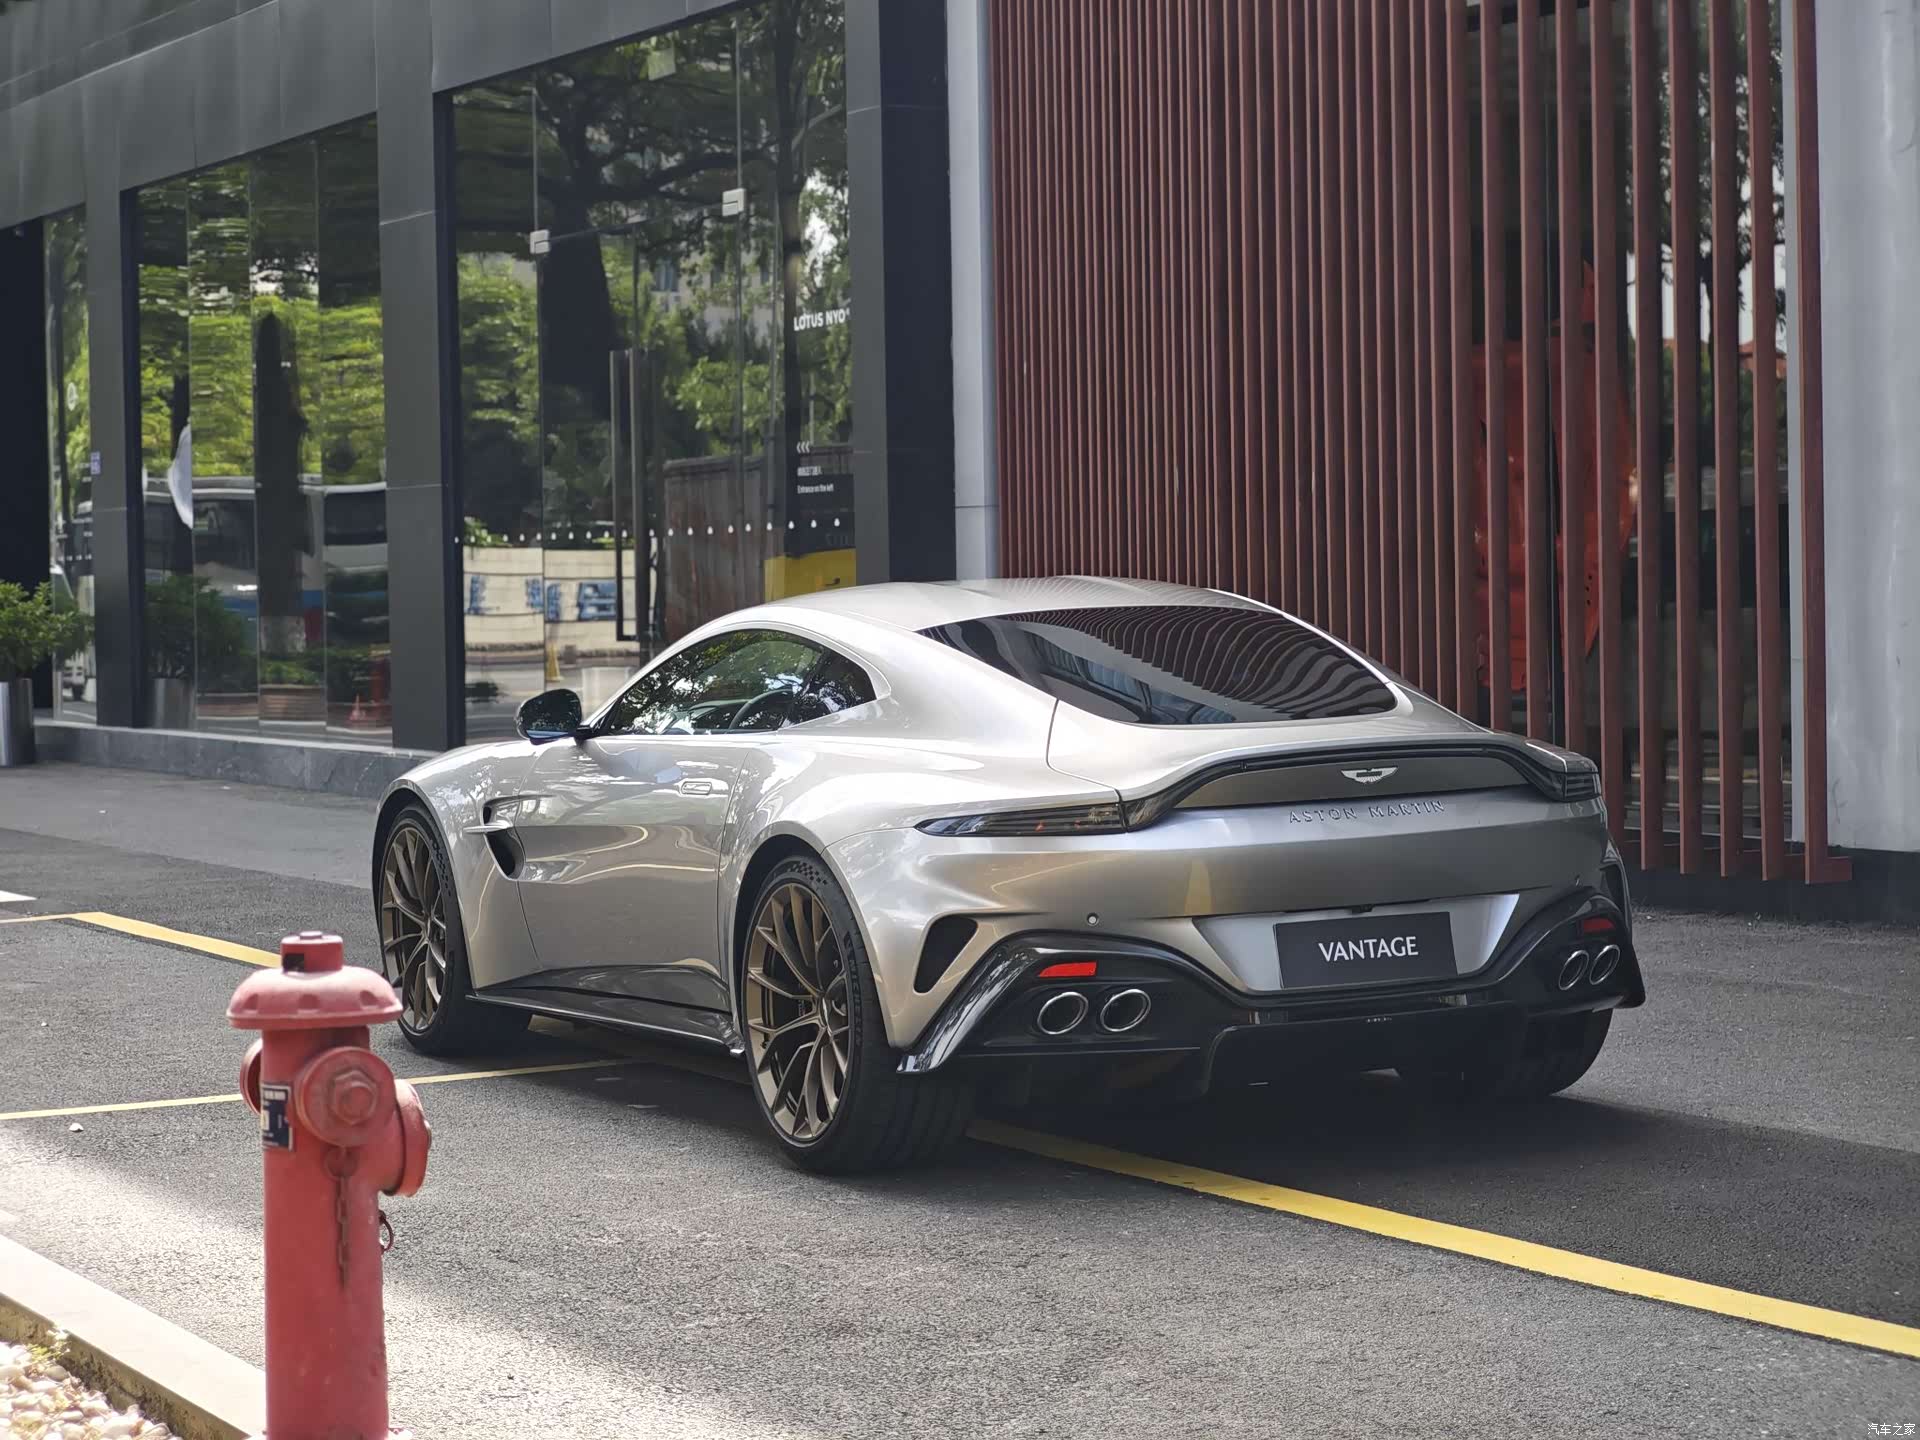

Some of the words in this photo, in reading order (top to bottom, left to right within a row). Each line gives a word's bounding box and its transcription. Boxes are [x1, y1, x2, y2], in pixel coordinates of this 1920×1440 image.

[793, 312, 824, 331] LOTUS
[1289, 807, 1357, 824] ASTON
[1368, 800, 1446, 818] MARTIN
[1318, 936, 1419, 962] VANTAGE
